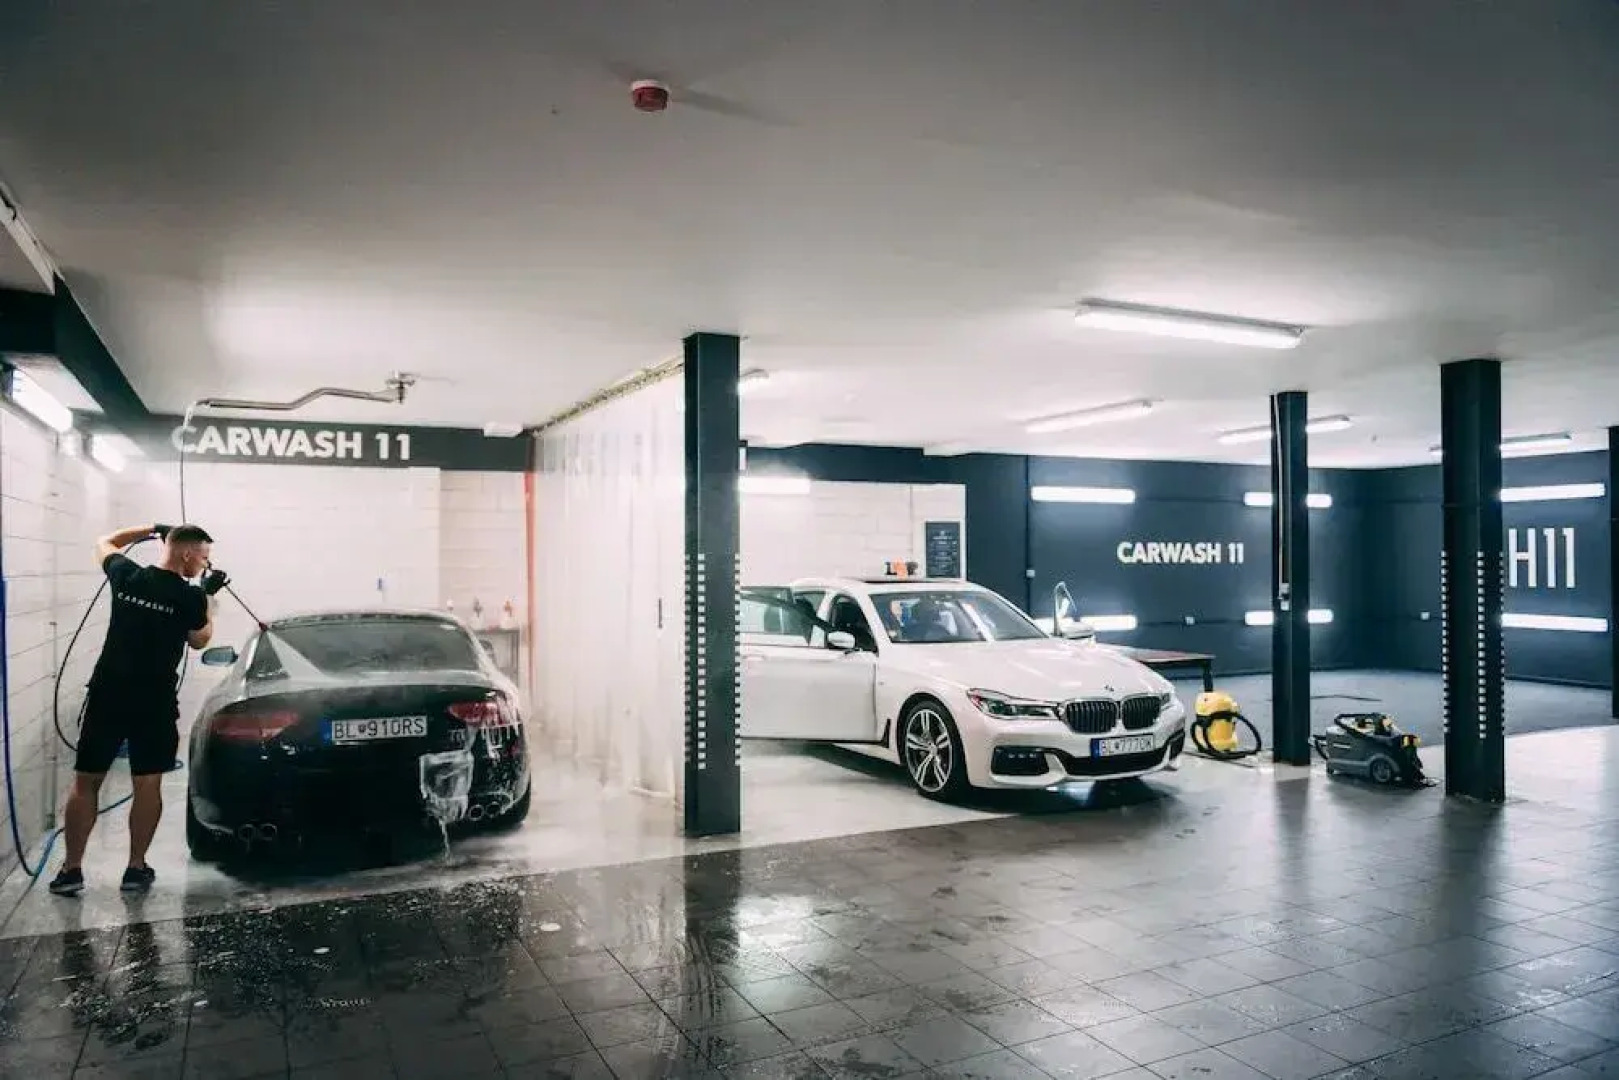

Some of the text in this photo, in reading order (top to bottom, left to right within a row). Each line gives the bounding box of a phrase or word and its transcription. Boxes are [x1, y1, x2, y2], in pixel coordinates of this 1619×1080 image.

[171, 425, 411, 460] CARWASH 11
[1116, 541, 1244, 564] CARWASH 11
[334, 722, 357, 739] BL
